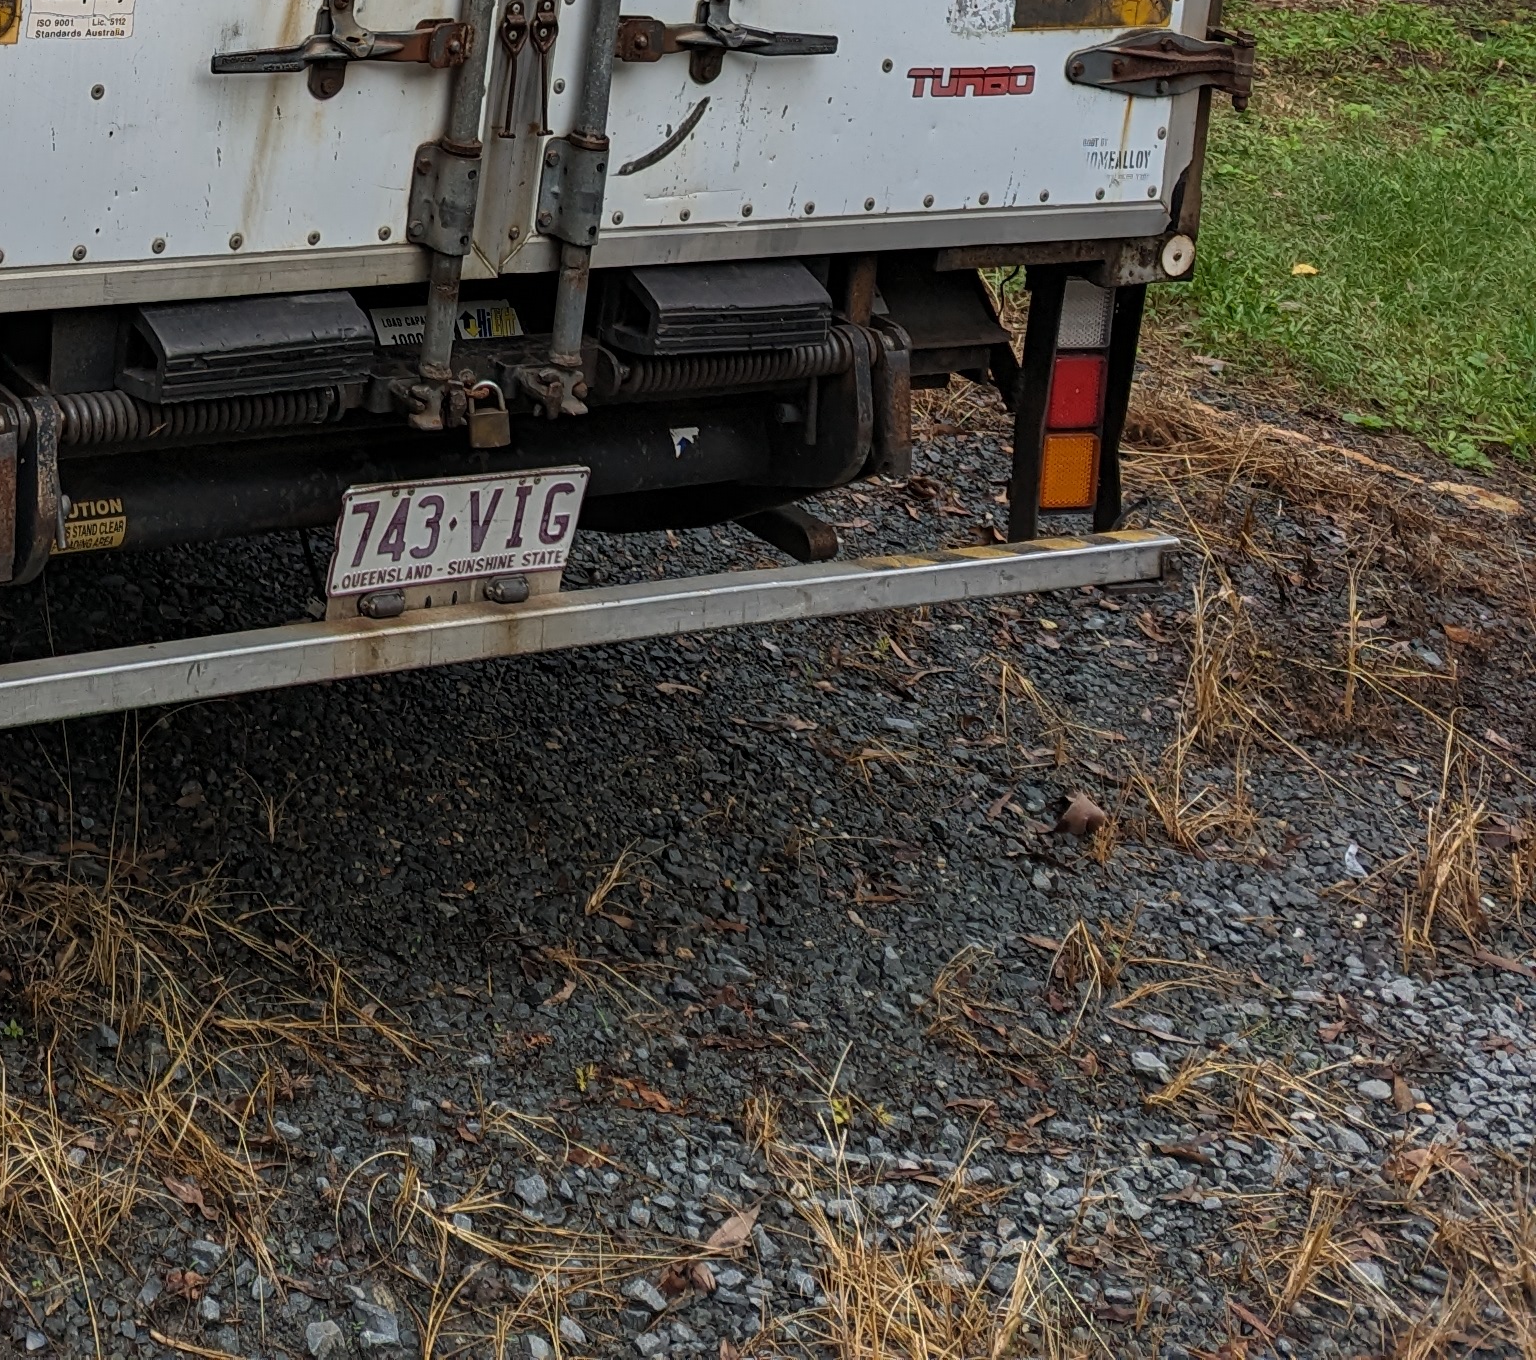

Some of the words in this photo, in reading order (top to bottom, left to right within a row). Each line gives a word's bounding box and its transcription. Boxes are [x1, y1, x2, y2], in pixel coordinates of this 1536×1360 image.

[36, 18, 52, 28] ISO
[54, 18, 74, 27] 9001
[110, 17, 126, 26] 5112
[35, 29, 82, 39] Standards
[85, 28, 125, 37] Australia
[907, 65, 1036, 98] TURBO
[380, 317, 403, 328] LOAD
[405, 316, 427, 327] CAPA
[66, 497, 124, 520] UTION
[73, 523, 97, 538] STAND
[99, 520, 124, 535] CLEAR
[342, 562, 433, 589] QUEENSLAND
[447, 553, 516, 575] SUNSHINE
[521, 550, 564, 566] STATE
